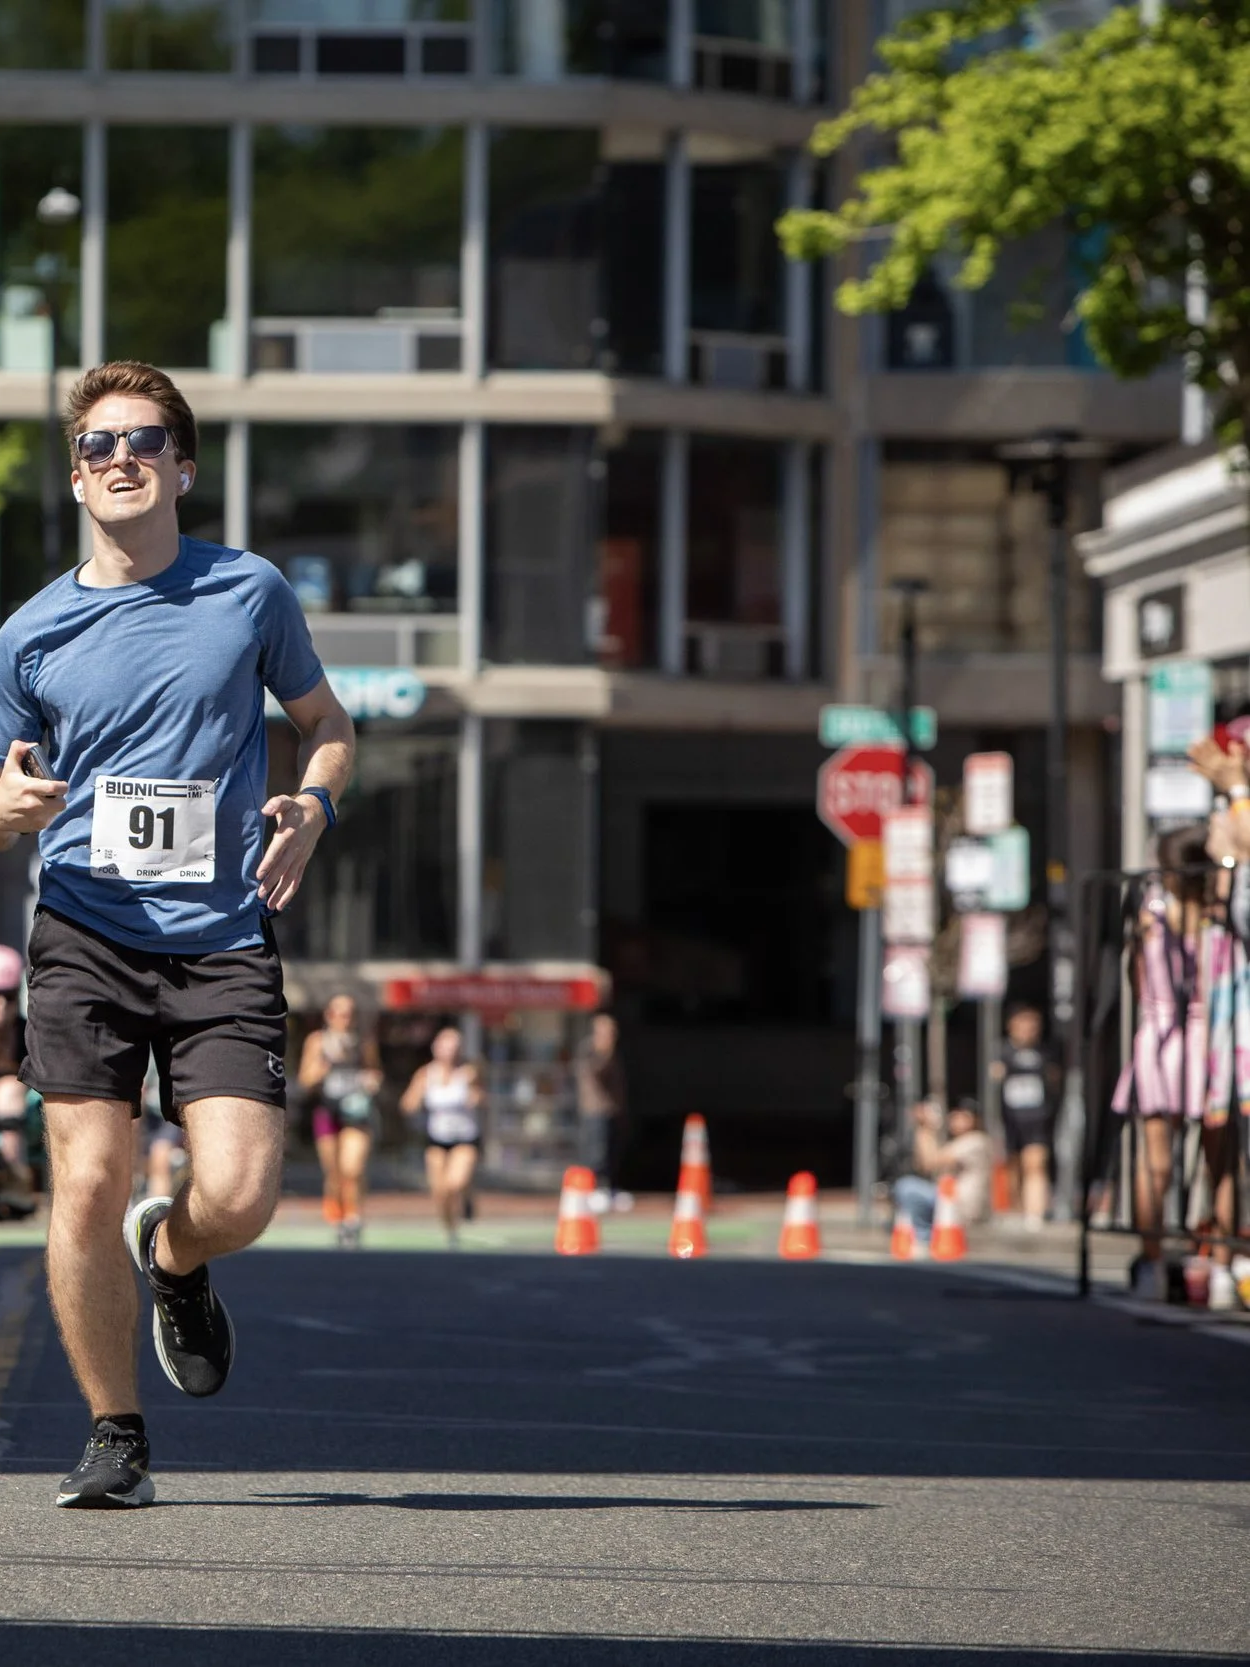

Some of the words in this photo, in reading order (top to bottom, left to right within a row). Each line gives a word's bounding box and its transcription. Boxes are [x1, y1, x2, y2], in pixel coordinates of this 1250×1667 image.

[105, 781, 187, 798] BIONIC
[128, 805, 175, 850] 91
[97, 866, 120, 876] FOOD
[136, 869, 163, 877] DRINK
[179, 870, 207, 878] DRINK
